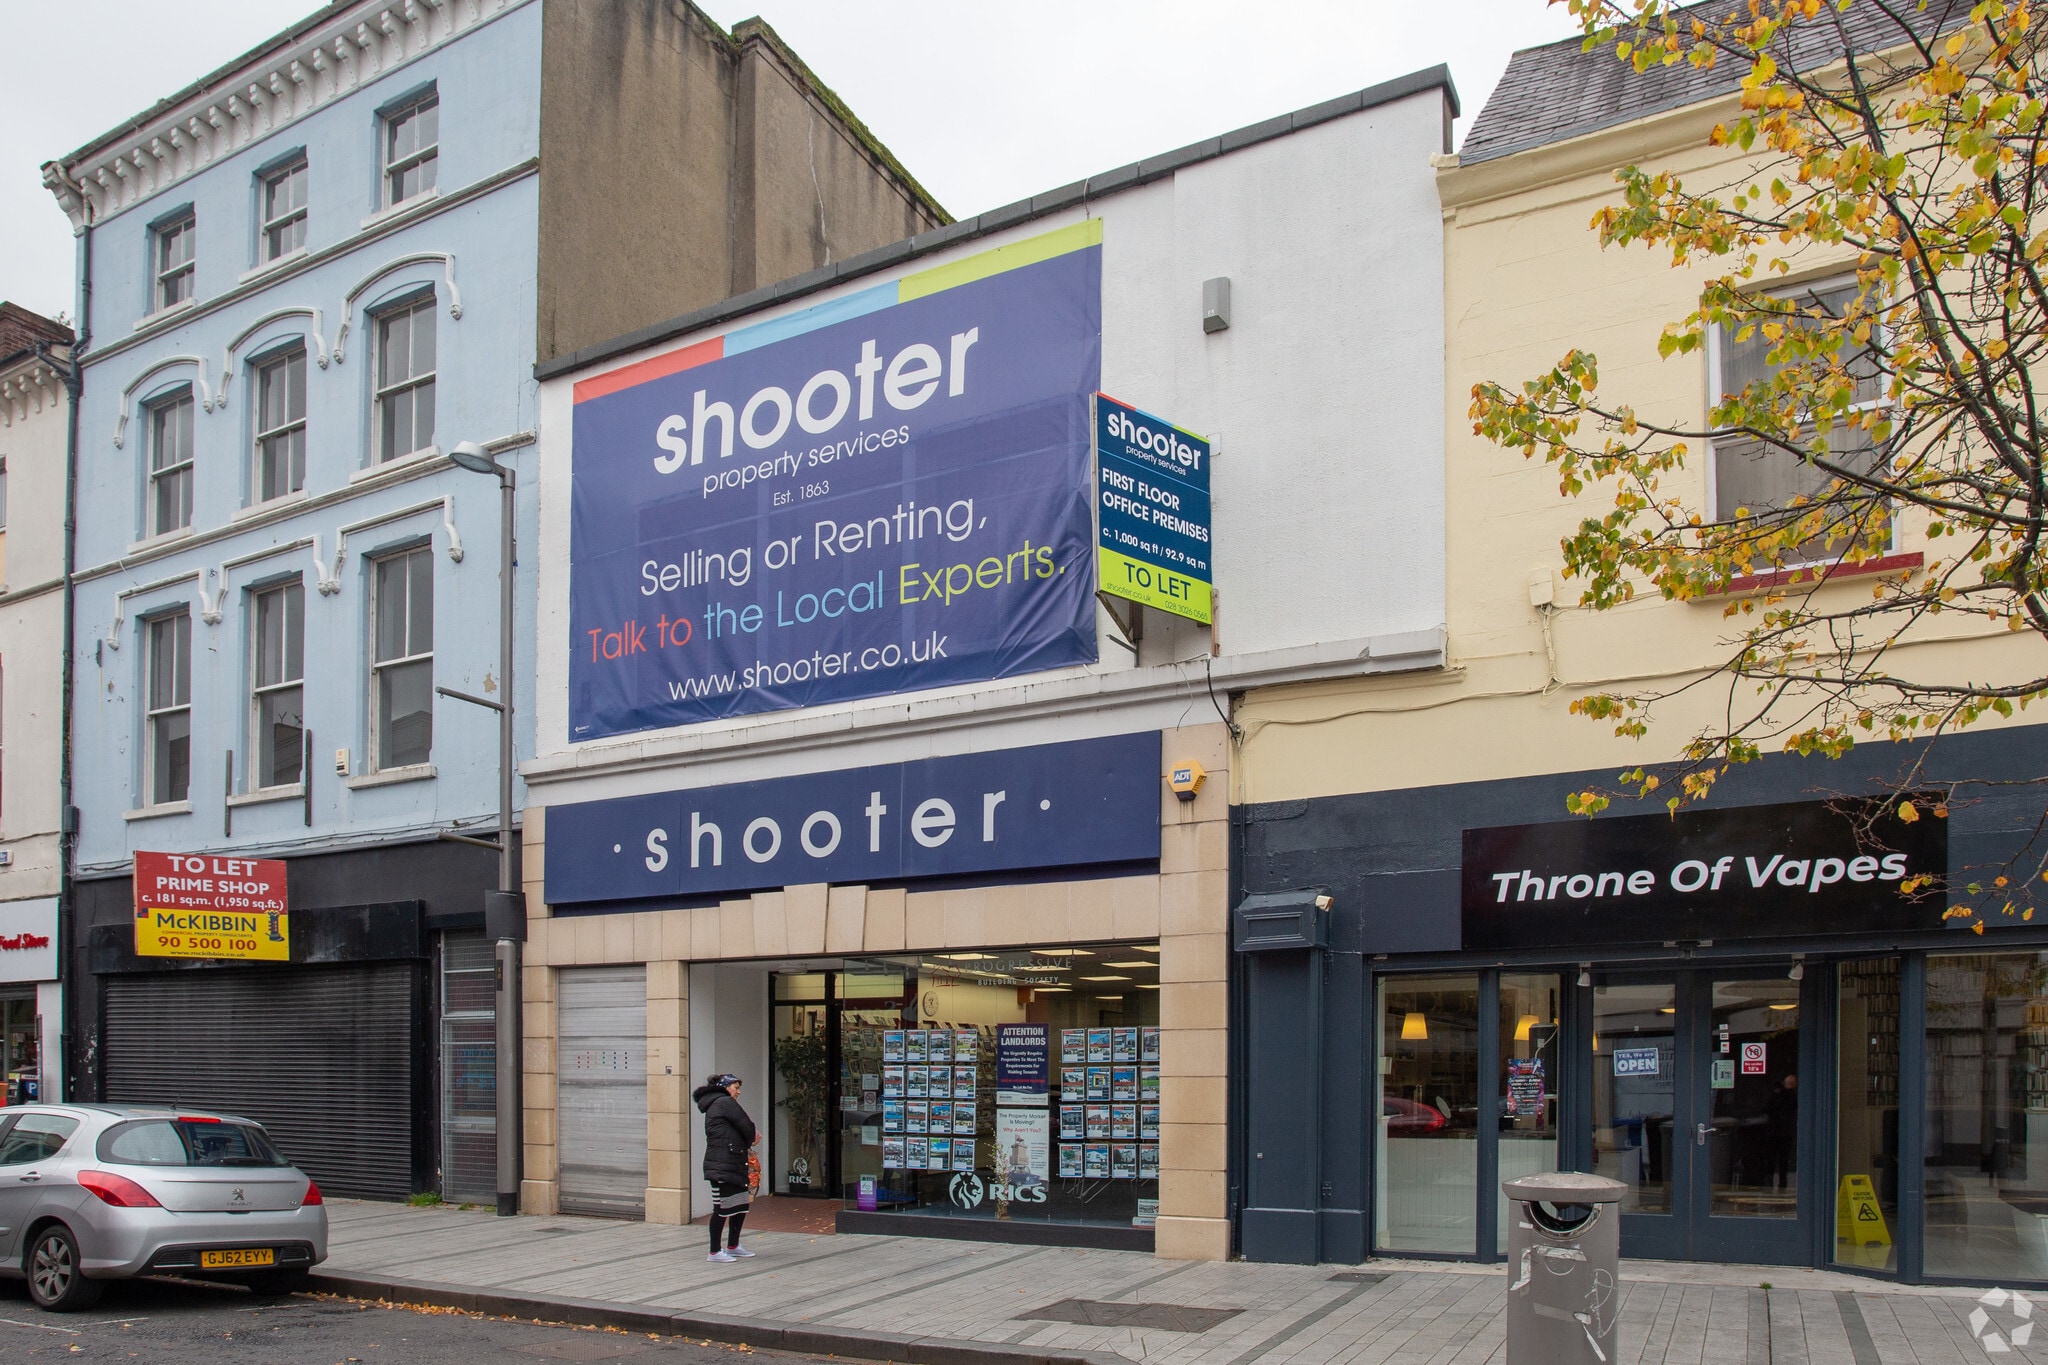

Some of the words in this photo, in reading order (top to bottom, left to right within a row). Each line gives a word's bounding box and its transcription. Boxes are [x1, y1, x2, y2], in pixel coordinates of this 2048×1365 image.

[654, 326, 978, 474] shooter
[1108, 411, 1200, 470] shooter
[703, 451, 802, 498] property
[808, 425, 909, 468] services
[1126, 445, 1157, 465] property
[1158, 459, 1186, 476] services
[774, 490, 794, 506] Est.
[801, 480, 830, 500] 1863
[1103, 467, 1134, 493] FIRST
[1139, 481, 1180, 511] FLOOR
[1103, 491, 1149, 521] OFFICE
[1153, 508, 1208, 542] PREMISES
[641, 546, 751, 596] Selling
[764, 535, 802, 570] or
[814, 498, 987, 559] Renting,
[1103, 528, 1112, 537] c.
[1114, 530, 1138, 547] 1,000
[1140, 541, 1150, 553] sq
[1152, 543, 1158, 554] ft
[1160, 547, 1164, 556] /
[1166, 548, 1184, 562] 92.9
[1186, 556, 1196, 568] sq
[1198, 561, 1206, 570] m
[1107, 582, 1151, 602] shooter.co.uk
[1124, 562, 1151, 588] TO
[1158, 573, 1191, 600] LET
[588, 620, 647, 663] Talk
[656, 614, 692, 648] to
[703, 602, 763, 641] the
[777, 570, 884, 628] Local
[900, 540, 1066, 606] Experts.
[1165, 601, 1176, 610] 028
[668, 631, 948, 701] www.shooter.co.uk
[1174, 772, 1190, 781] ADT
[645, 790, 1006, 872] shooter
[168, 856, 205, 873] TO
[213, 858, 258, 876] LET
[156, 877, 213, 892] PRIME
[218, 880, 270, 895] SHOP
[1492, 870, 1656, 903] Throne
[1670, 856, 1735, 892] Of
[1744, 853, 1908, 893] Vapes
[142, 894, 152, 902] c.
[157, 893, 175, 903] 181
[180, 896, 211, 906] sq.m.
[215, 896, 249, 908] (1,950
[252, 900, 284, 911] sq.ft.)
[157, 913, 256, 932] McKIBBIN
[158, 937, 180, 948] 90
[188, 938, 221, 949] 500
[230, 940, 256, 950] 100
[964, 957, 1073, 972] PROGRESSIVE
[1003, 1028, 1044, 1036] ATTENTION
[1618, 1059, 1654, 1071] OPEN
[789, 1176, 812, 1184] RICS
[990, 1184, 1047, 1203] RICS
[208, 1251, 241, 1264] GJ62
[245, 1250, 268, 1262] EYY
